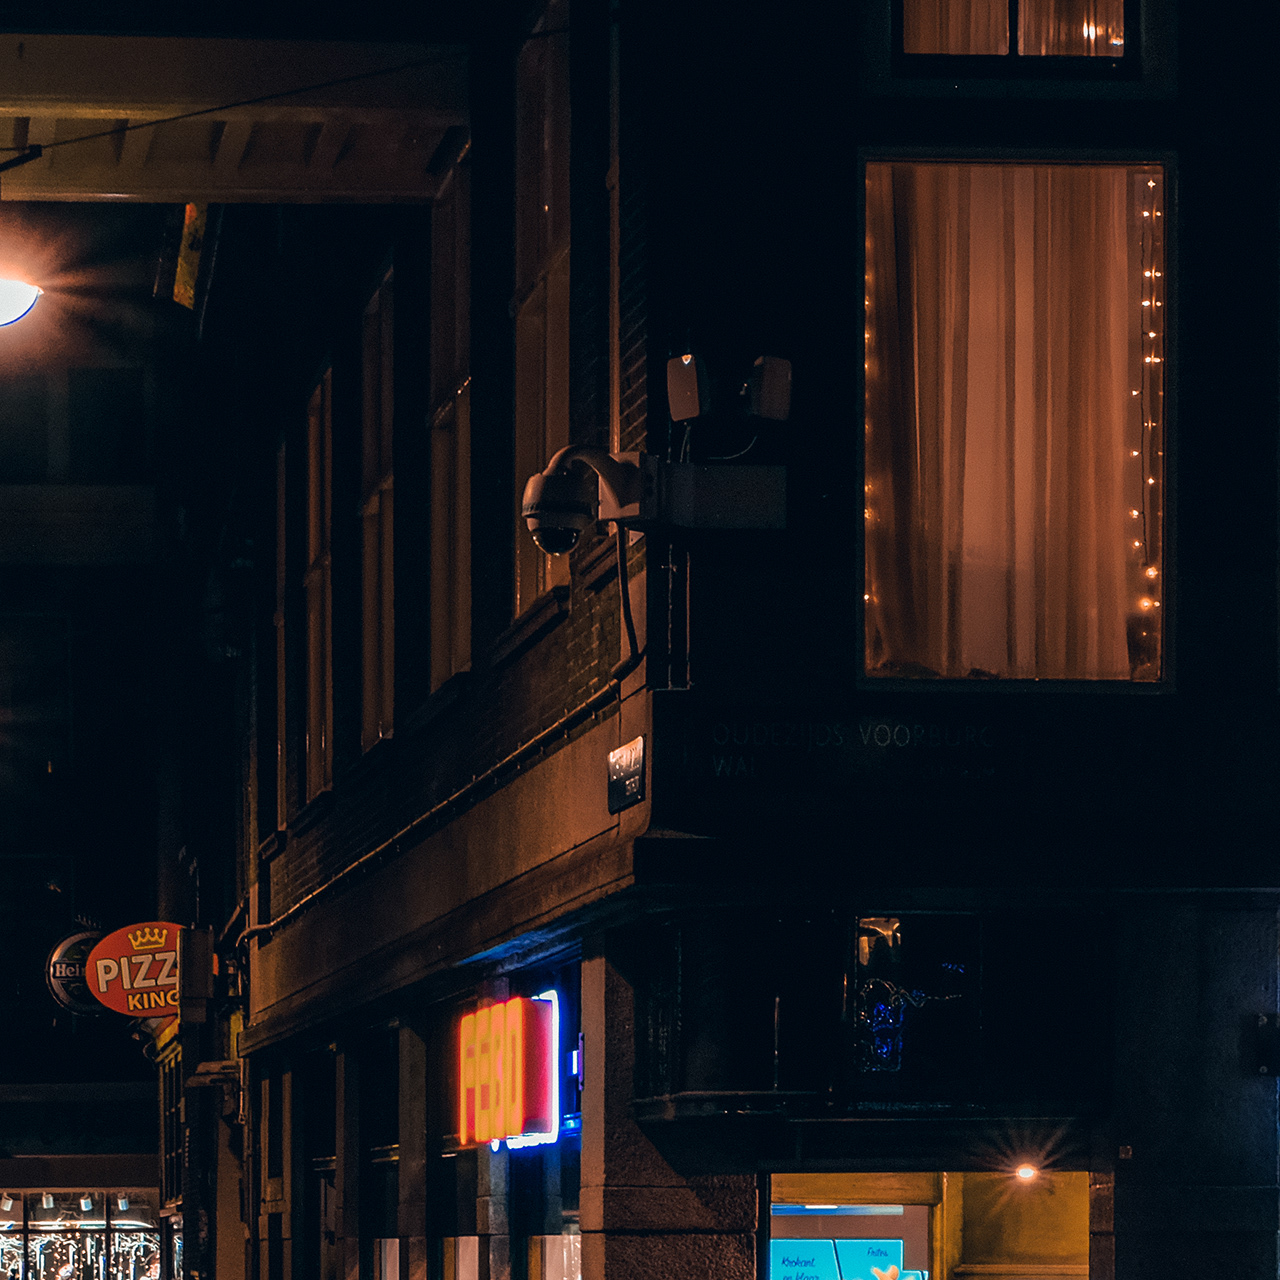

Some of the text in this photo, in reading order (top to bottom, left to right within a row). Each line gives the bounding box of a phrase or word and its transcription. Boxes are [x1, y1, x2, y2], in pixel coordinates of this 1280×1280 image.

[459, 995, 523, 1145] FEBO
[866, 1247, 888, 1257] Frites
[781, 1256, 816, 1267] Krokant
